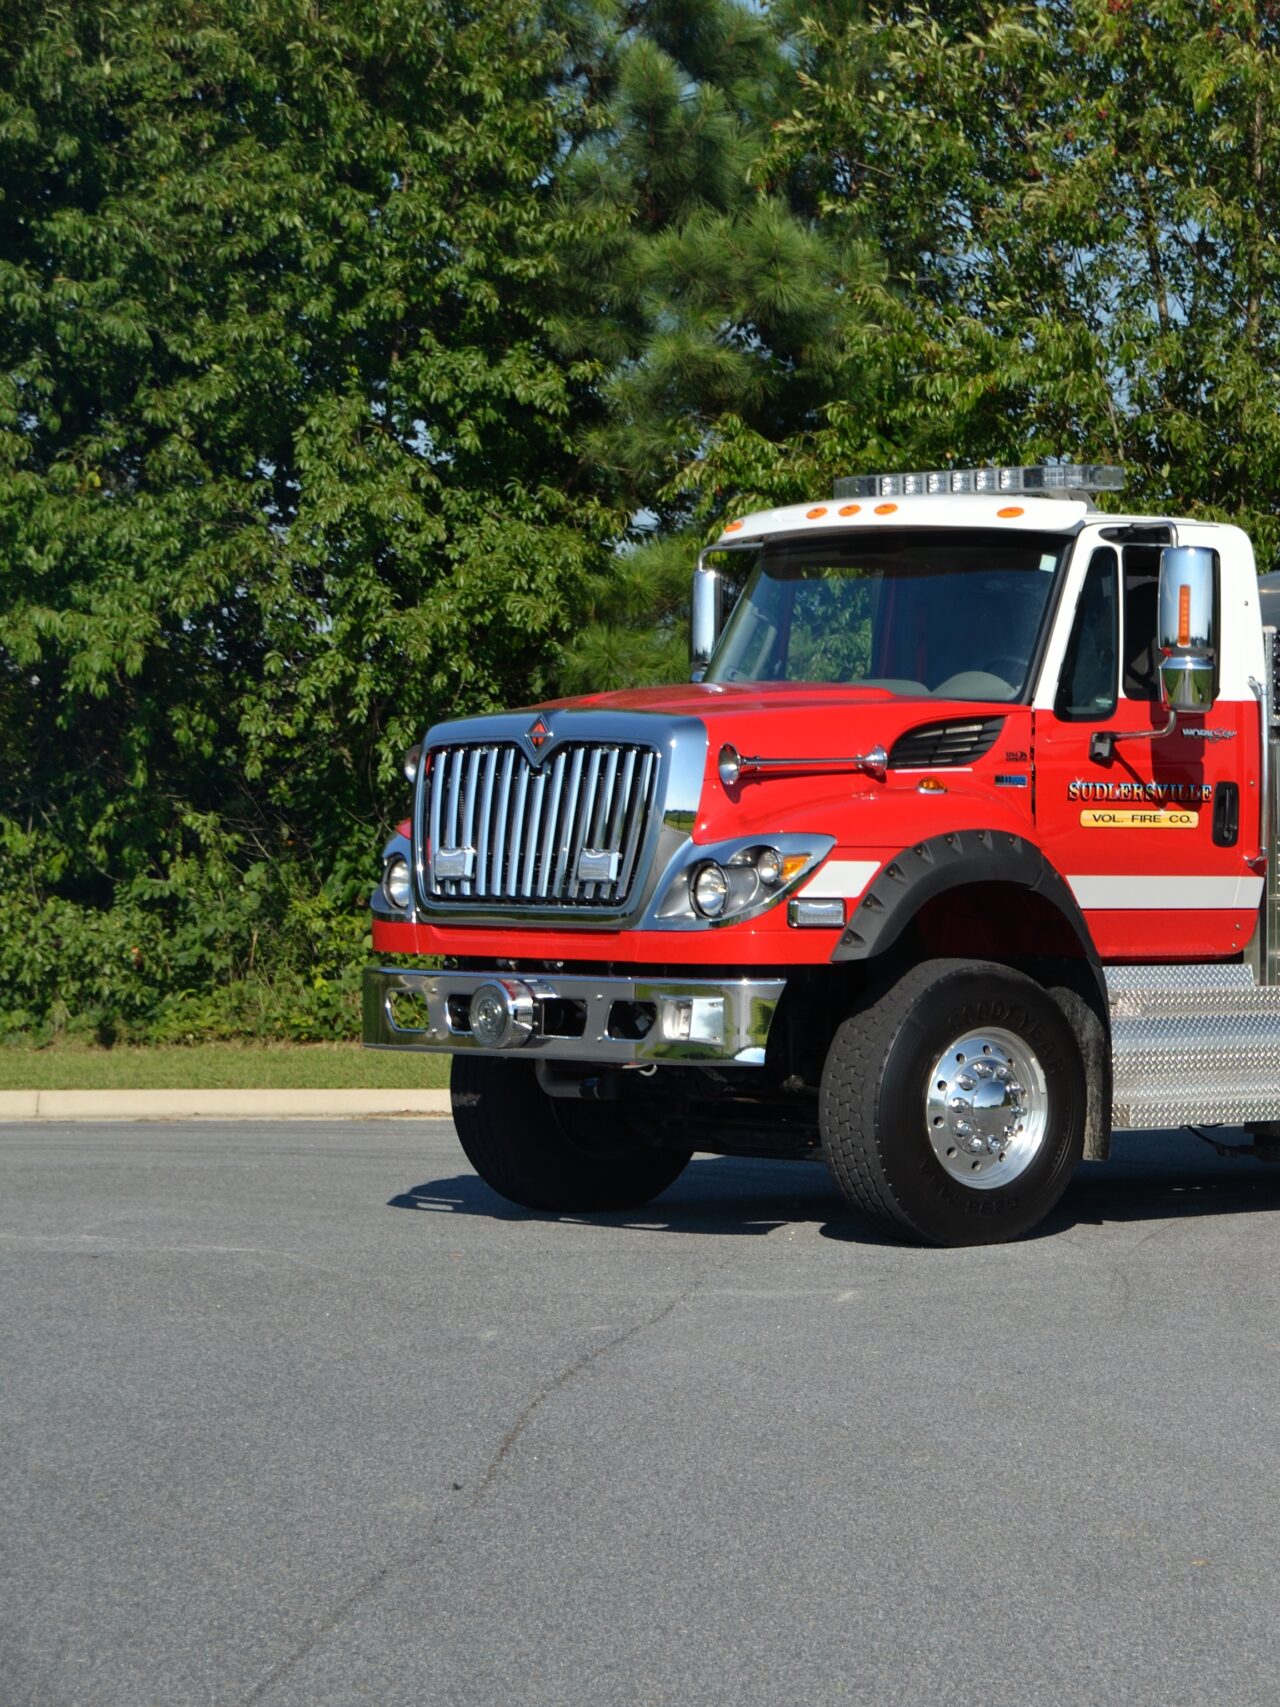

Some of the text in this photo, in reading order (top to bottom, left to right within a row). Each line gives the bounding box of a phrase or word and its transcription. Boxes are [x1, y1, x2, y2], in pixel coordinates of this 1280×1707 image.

[1068, 782, 1212, 803] SUDLERSVILLE
[1092, 813, 1193, 824] VOL. FIRE CO.
